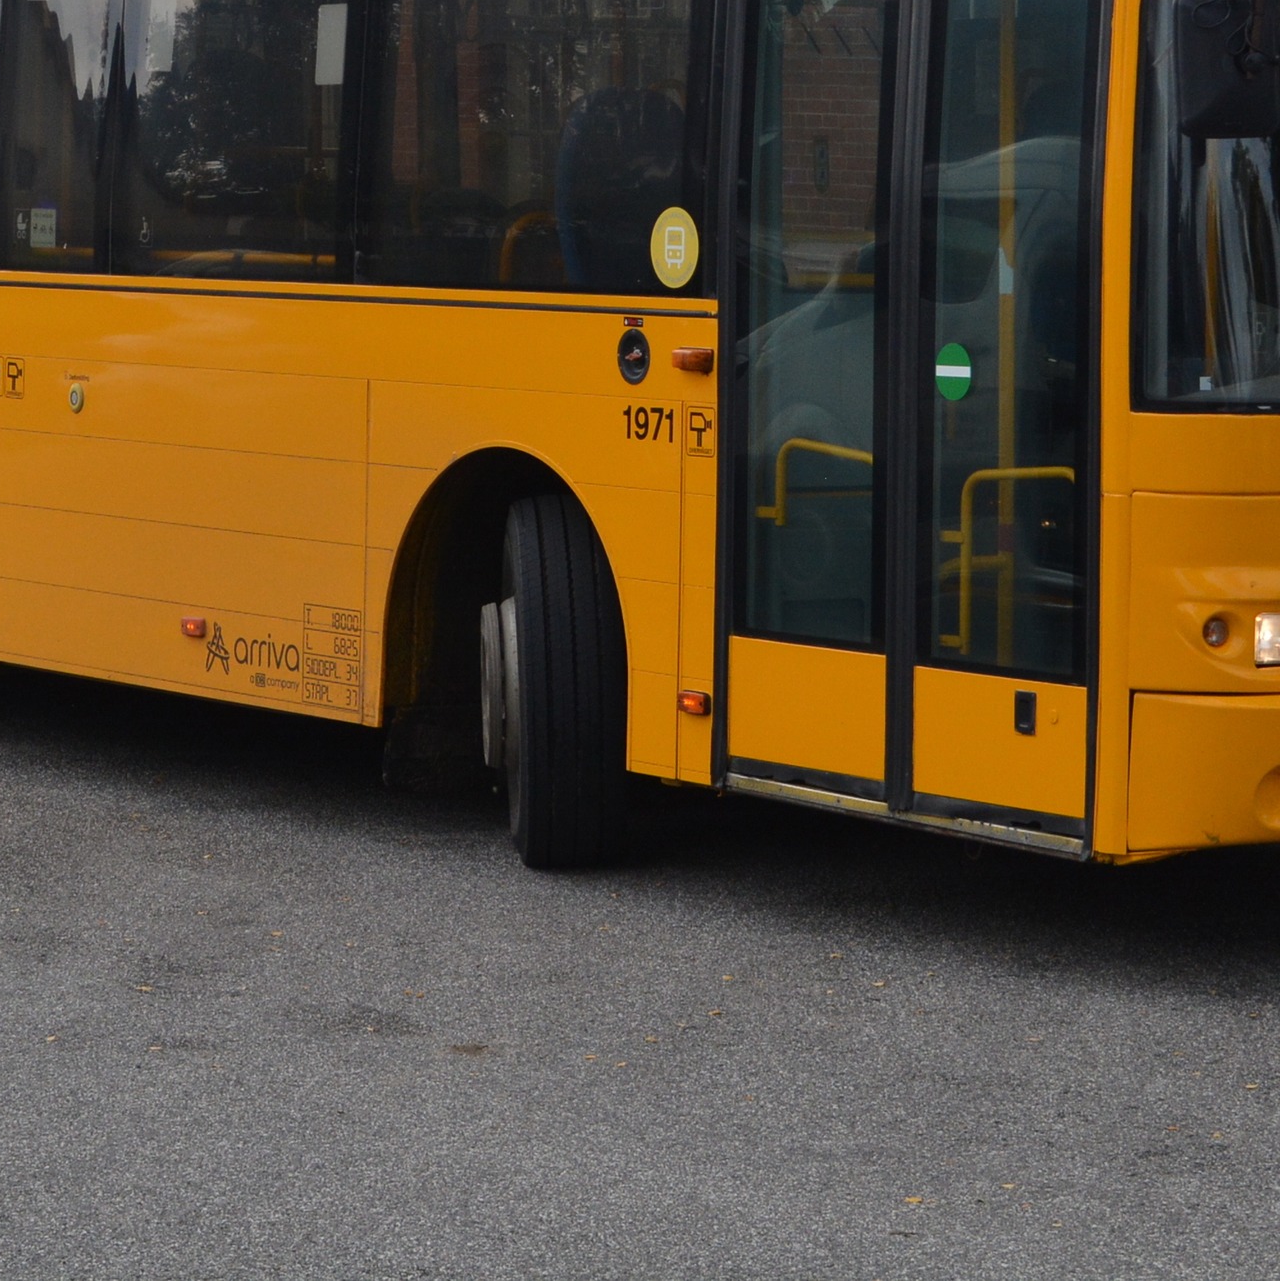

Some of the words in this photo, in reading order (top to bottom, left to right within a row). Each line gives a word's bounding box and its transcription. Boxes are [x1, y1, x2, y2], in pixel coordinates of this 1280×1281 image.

[622, 404, 675, 444] 1971
[331, 612, 359, 633] 18000
[233, 633, 300, 672] arriva
[305, 634, 313, 650] L
[333, 637, 358, 657] 6825
[346, 663, 358, 682] 34
[266, 677, 300, 692] company
[345, 689, 357, 707] 37
